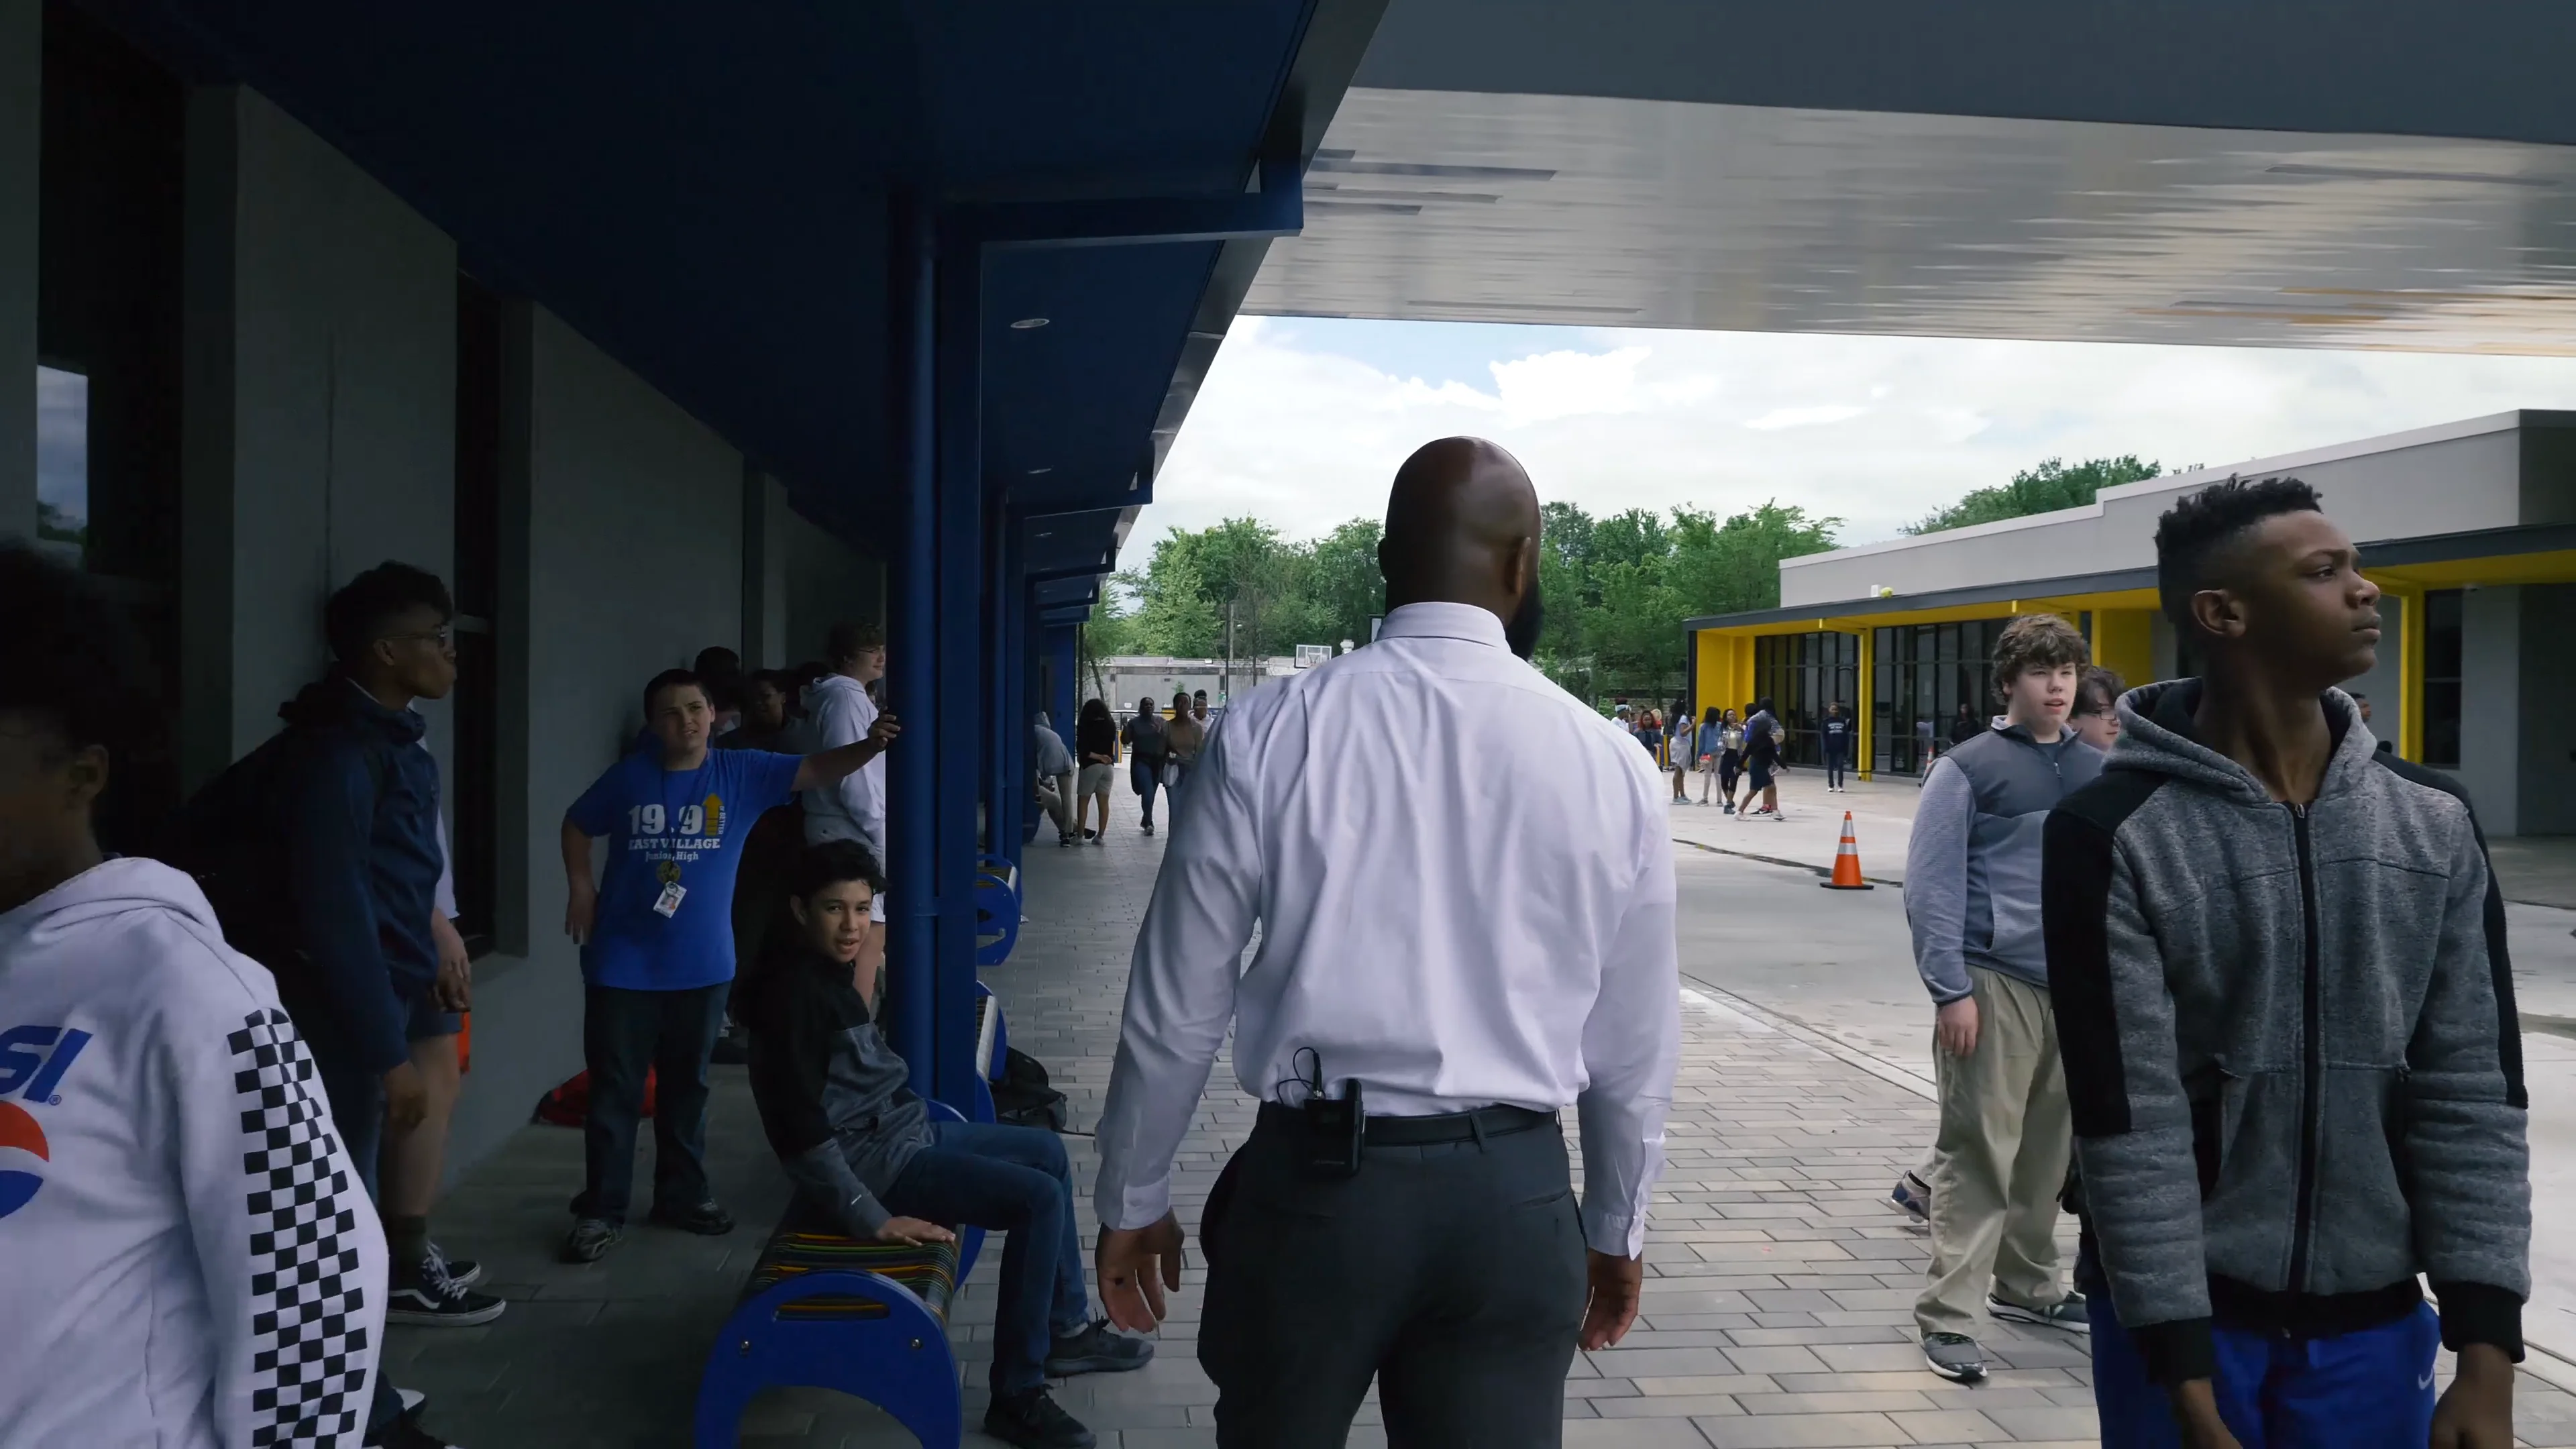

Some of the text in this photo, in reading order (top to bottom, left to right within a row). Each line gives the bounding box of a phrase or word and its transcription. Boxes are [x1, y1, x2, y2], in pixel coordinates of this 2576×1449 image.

[628, 838, 720, 851] EAST VILLAGE
[676, 851, 698, 862] High
